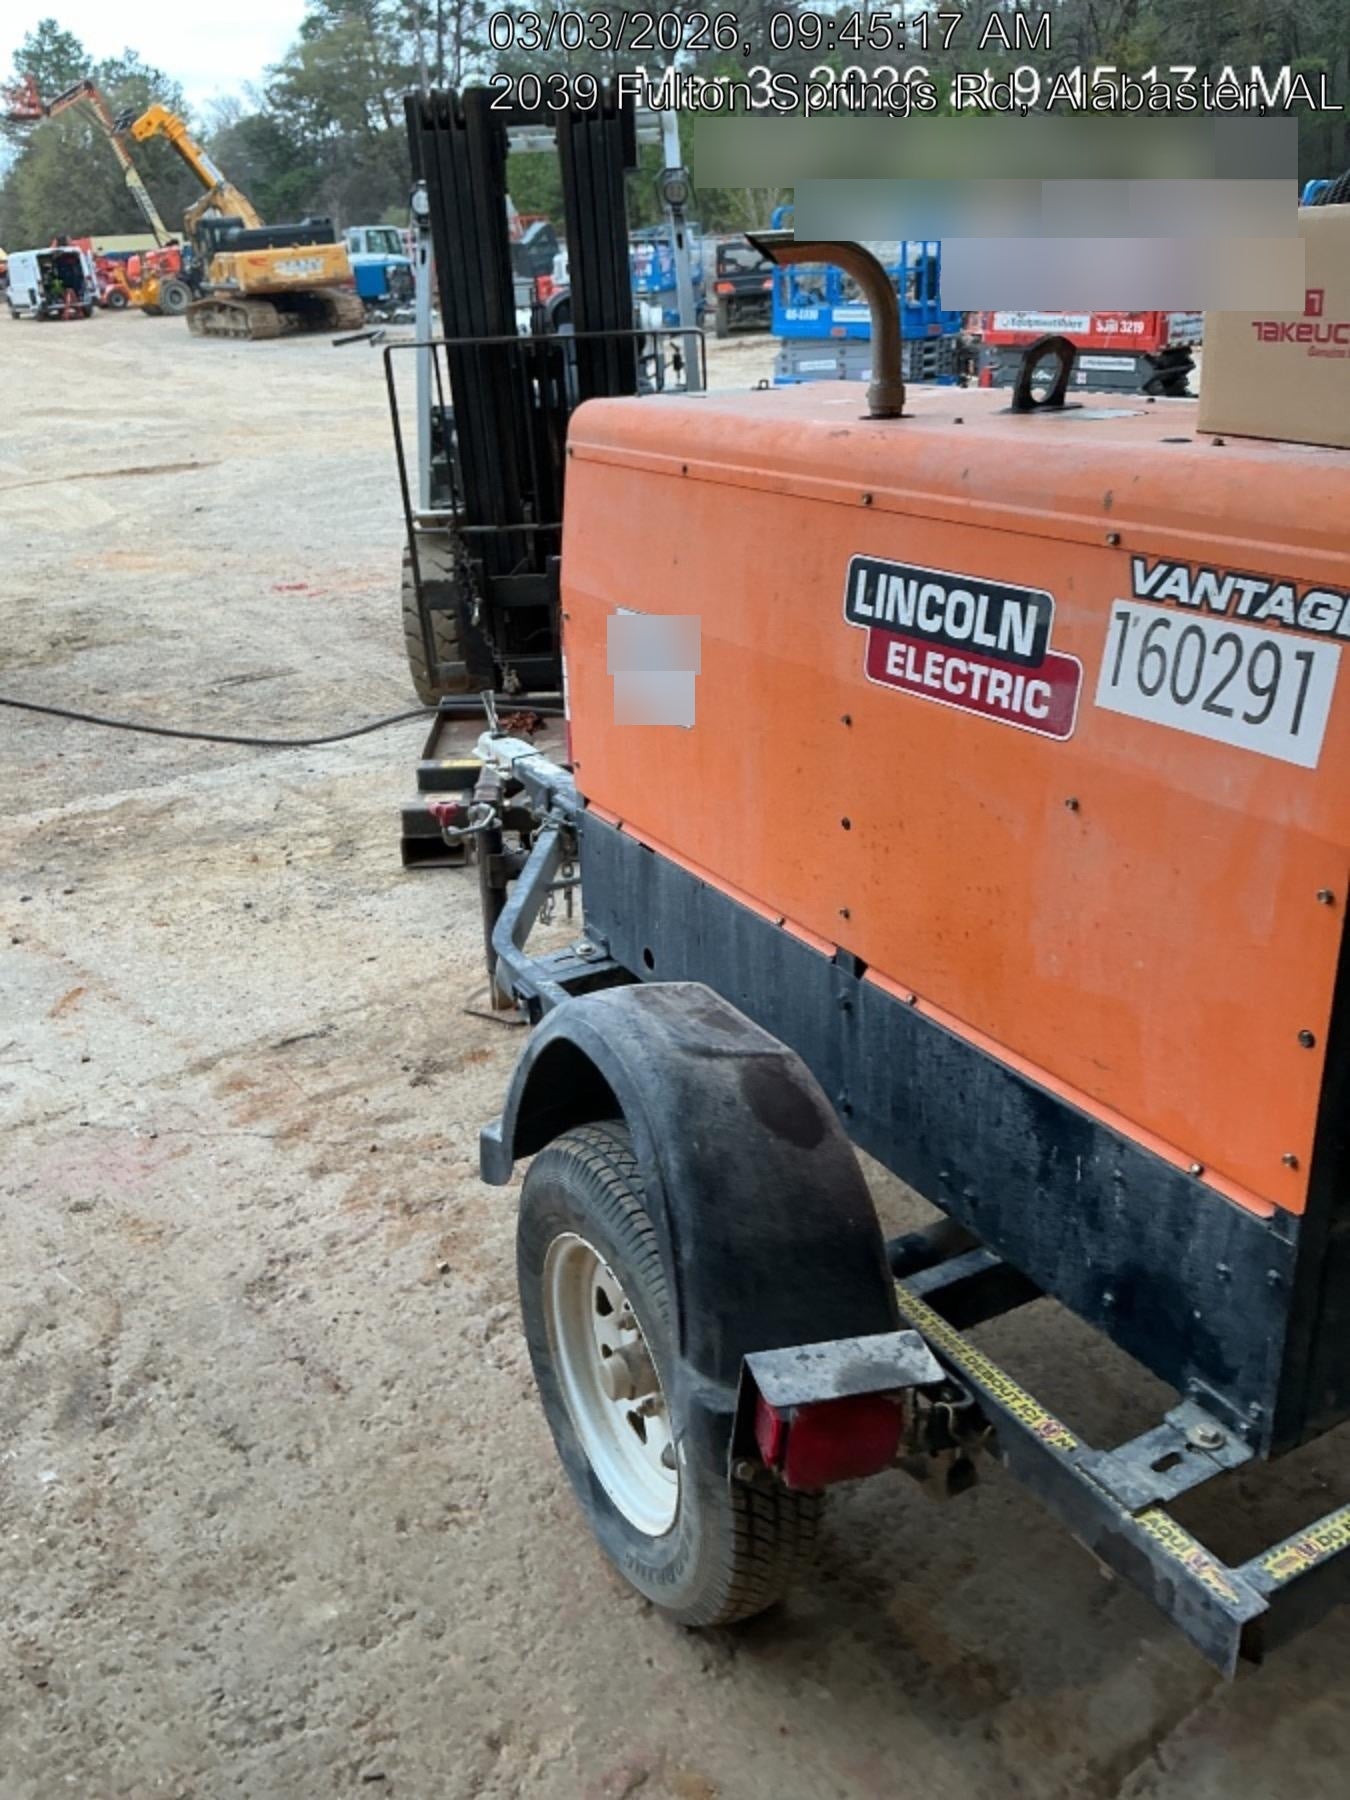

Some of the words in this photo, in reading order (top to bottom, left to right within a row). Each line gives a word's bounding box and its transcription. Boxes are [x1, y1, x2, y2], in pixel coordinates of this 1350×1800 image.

[854, 569, 1039, 657] LINCOLN
[886, 640, 1052, 720] ELECTRIC
[1114, 611, 1316, 737] 160291
[964, 1354, 1022, 1402] DEBOUT
[1019, 1402, 1042, 1423] ICI
[1316, 1527, 1345, 1548] DO
